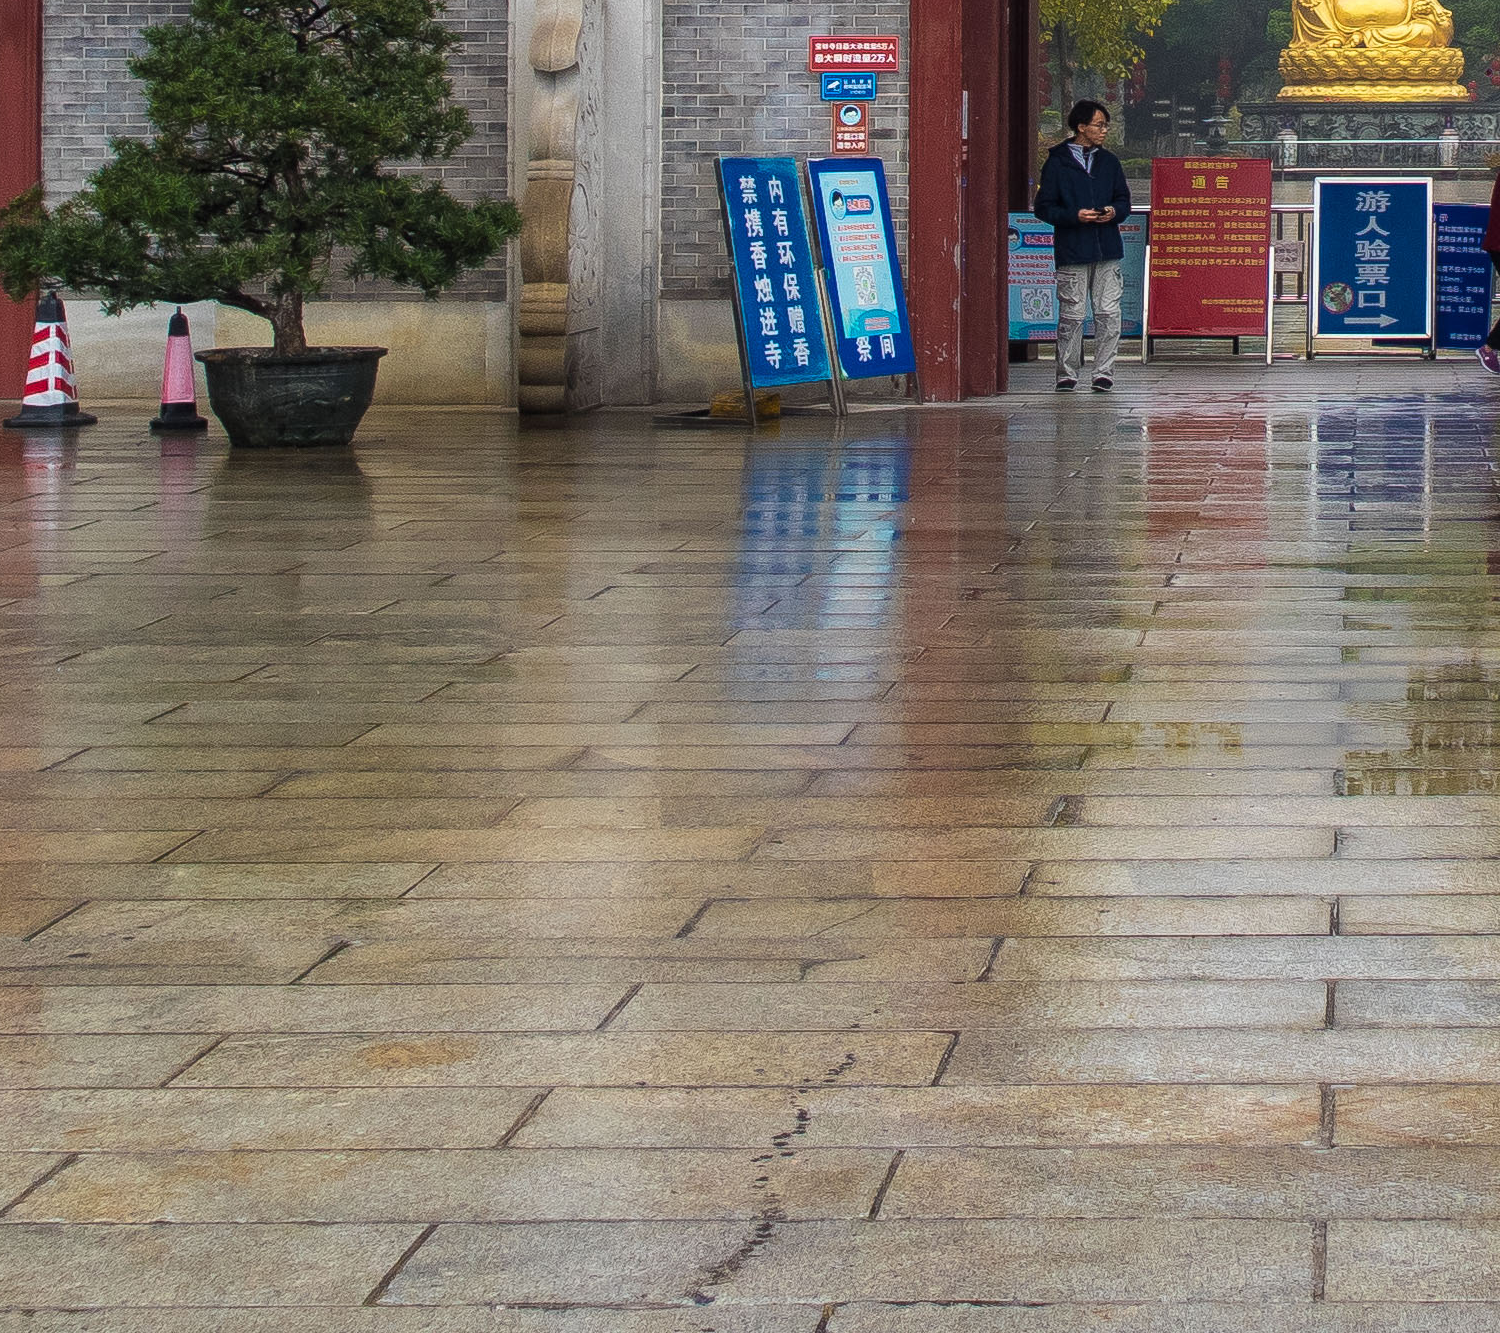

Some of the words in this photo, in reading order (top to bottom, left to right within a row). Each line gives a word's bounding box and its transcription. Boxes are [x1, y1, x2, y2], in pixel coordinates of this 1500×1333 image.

[1191, 175, 1230, 190] 通告
[1354, 190, 1392, 309] 游人验票口
[738, 174, 783, 370] 禁携香烛进寺
[767, 174, 811, 367] 内有环保赠香
